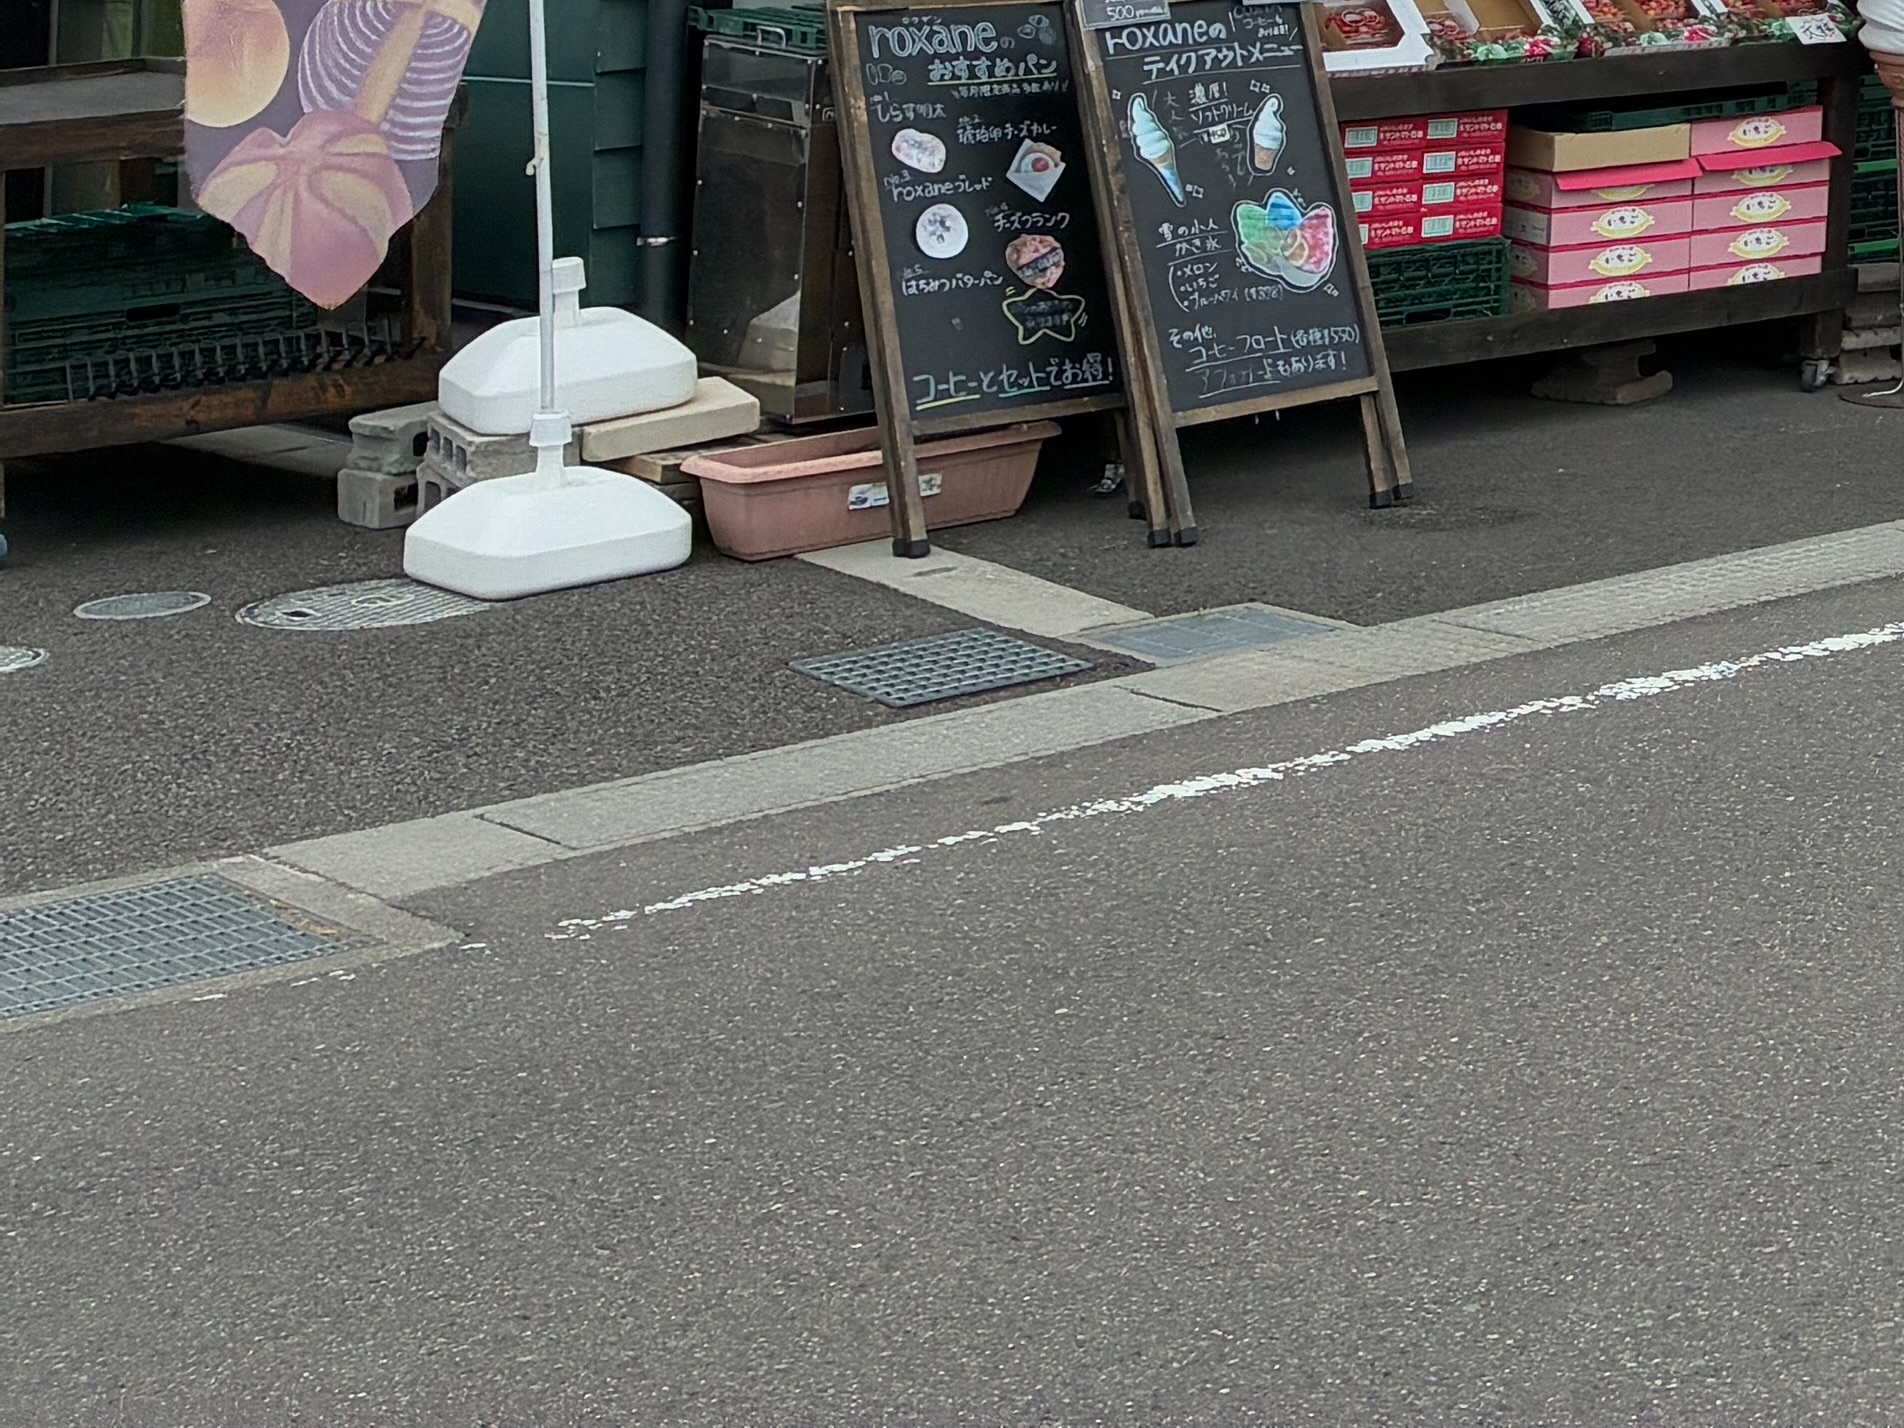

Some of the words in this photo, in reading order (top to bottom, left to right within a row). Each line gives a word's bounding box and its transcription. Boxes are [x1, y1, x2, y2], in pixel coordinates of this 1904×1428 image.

[1105, 19, 1227, 55] roxaneの
[927, 53, 1058, 83] おすすめパン
[1142, 41, 1304, 81] テイクアウトメニュー
[1190, 102, 1254, 125] ソフトクリーム
[901, 270, 1004, 296] はちみつバターパン
